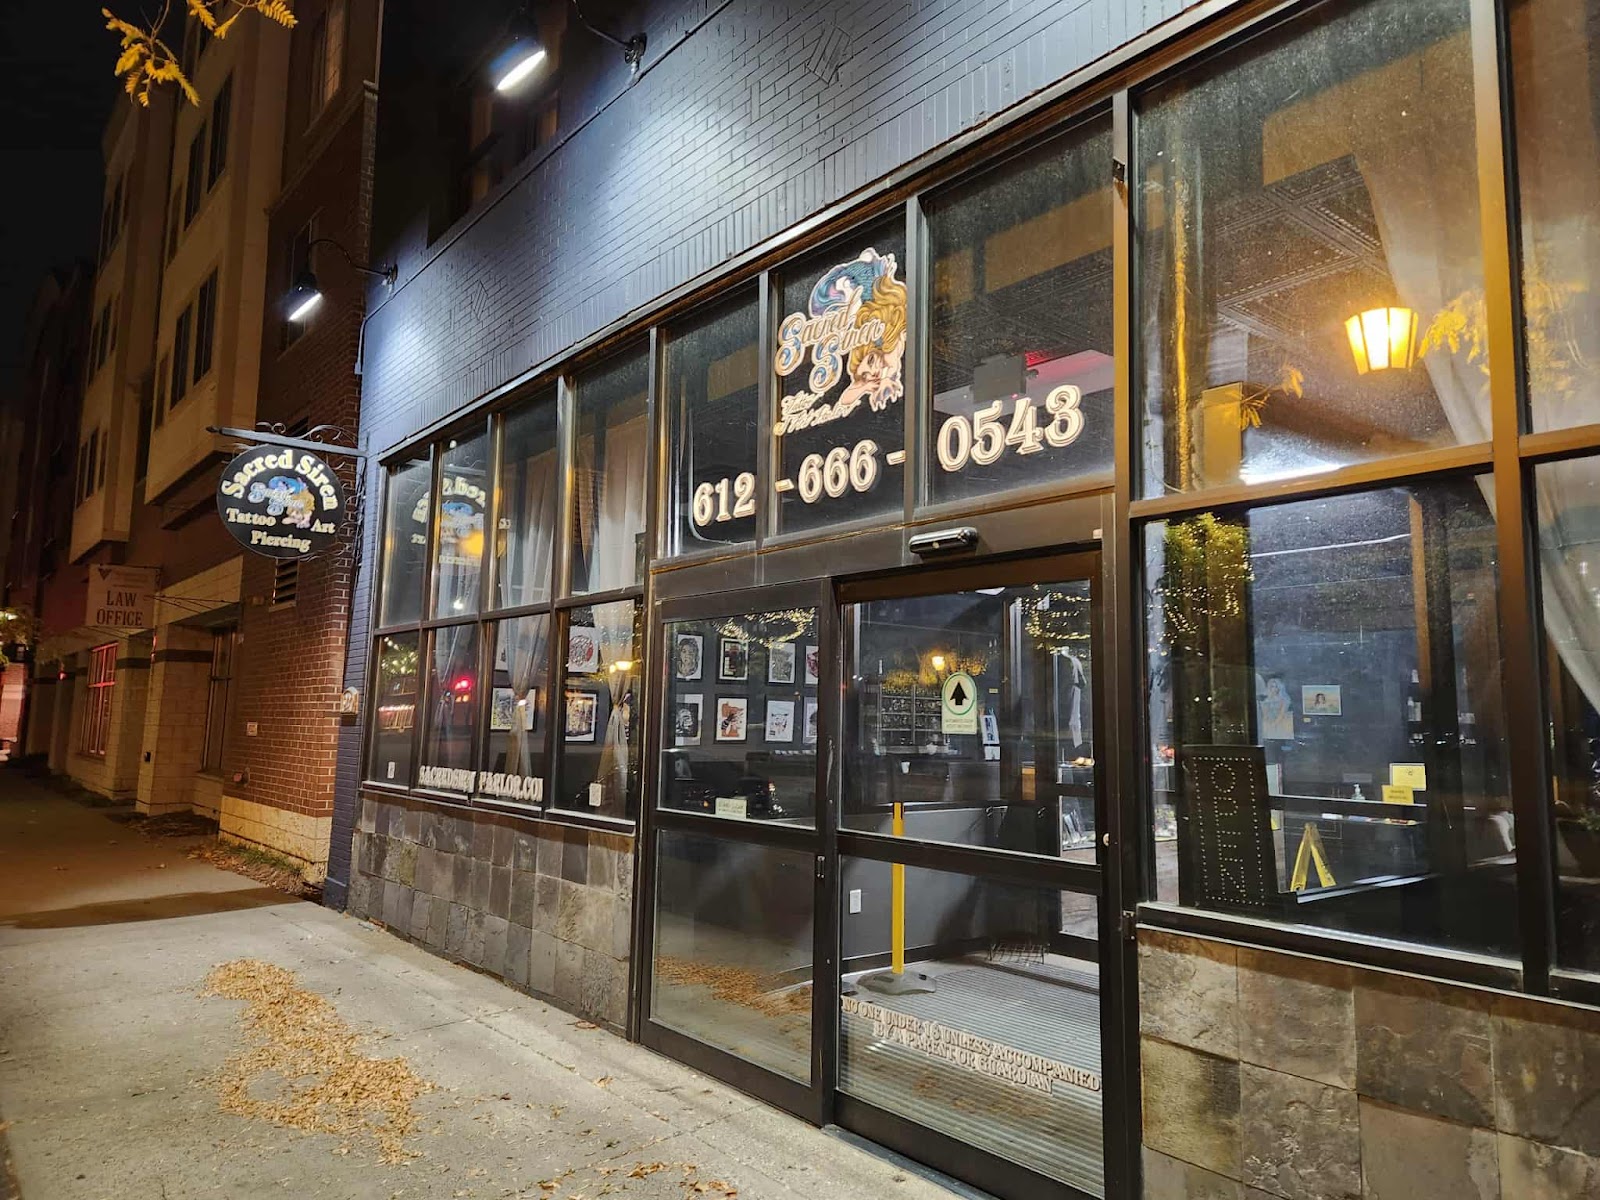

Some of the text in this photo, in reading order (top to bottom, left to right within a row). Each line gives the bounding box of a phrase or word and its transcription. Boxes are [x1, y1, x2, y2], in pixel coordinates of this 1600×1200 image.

[221, 449, 294, 499] Sacred
[295, 455, 338, 511] Siren
[692, 473, 755, 526] 612
[937, 384, 1083, 472] 0543
[226, 507, 336, 534] Tattoo Art
[250, 529, 311, 553] Piercing
[96, 608, 143, 626] OFFICE
[106, 590, 136, 607] LAW
[1211, 762, 1247, 899] OPEN
[859, 1001, 882, 1022] ONE
[881, 1008, 922, 1036] UNDER
[940, 1023, 992, 1057] UNLESS
[991, 1042, 1100, 1092] ACCOMPANIED
[904, 1031, 957, 1062] PARENT
[956, 1048, 976, 1070] OR
[976, 1054, 1054, 1096] GUARDIAN
